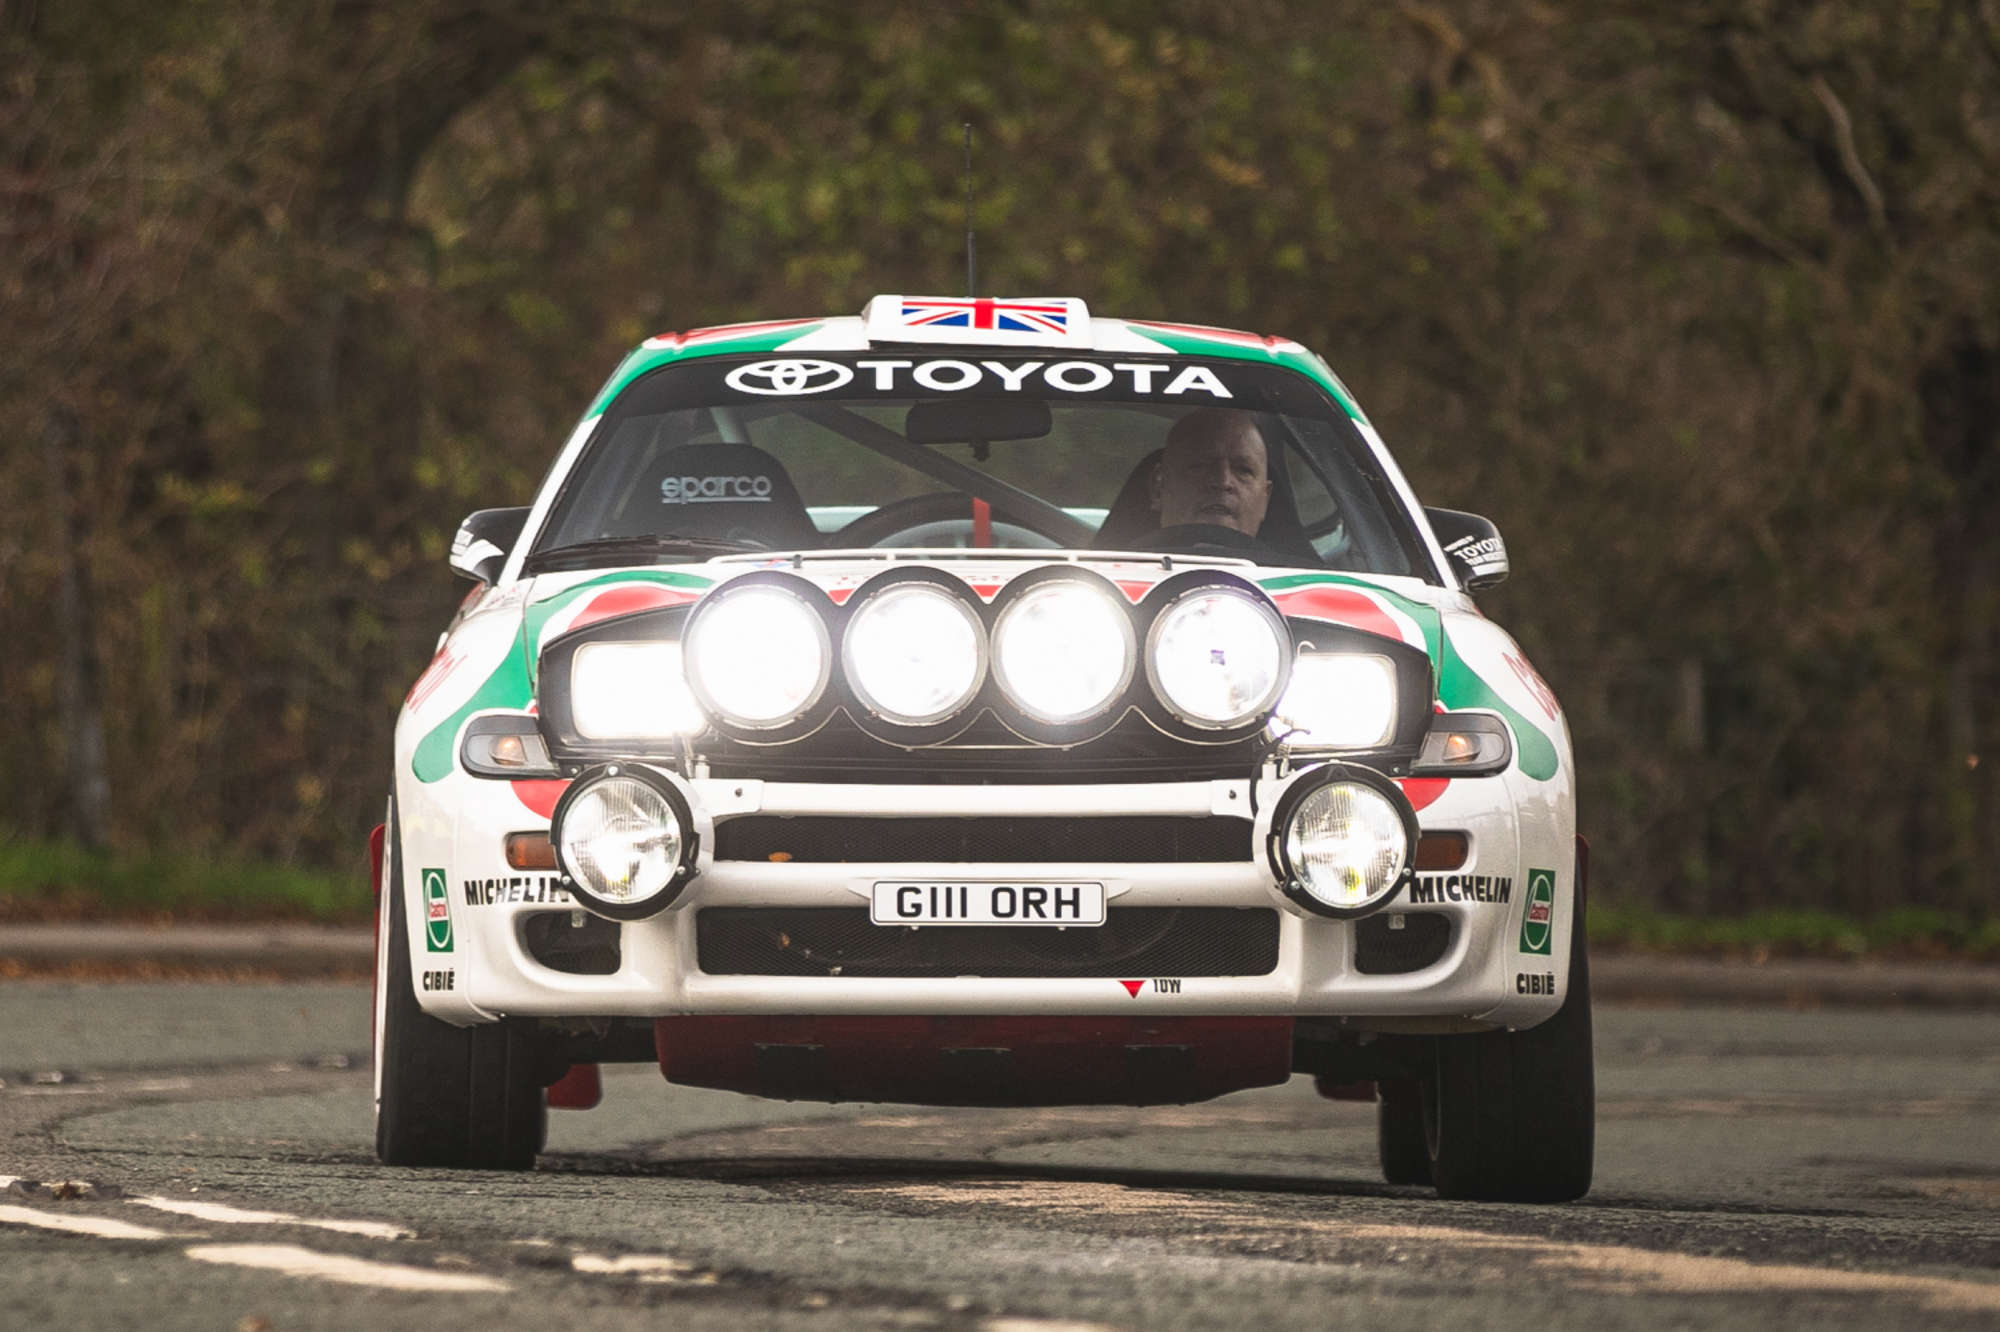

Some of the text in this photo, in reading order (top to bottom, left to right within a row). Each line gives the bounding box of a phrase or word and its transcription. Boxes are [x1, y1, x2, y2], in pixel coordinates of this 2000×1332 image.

[856, 360, 1234, 399] TOYOTA
[661, 476, 772, 504] sparco
[991, 886, 1080, 919] ORH
[1410, 875, 1512, 904] MICHELIN
[1153, 979, 1181, 993] TOW
